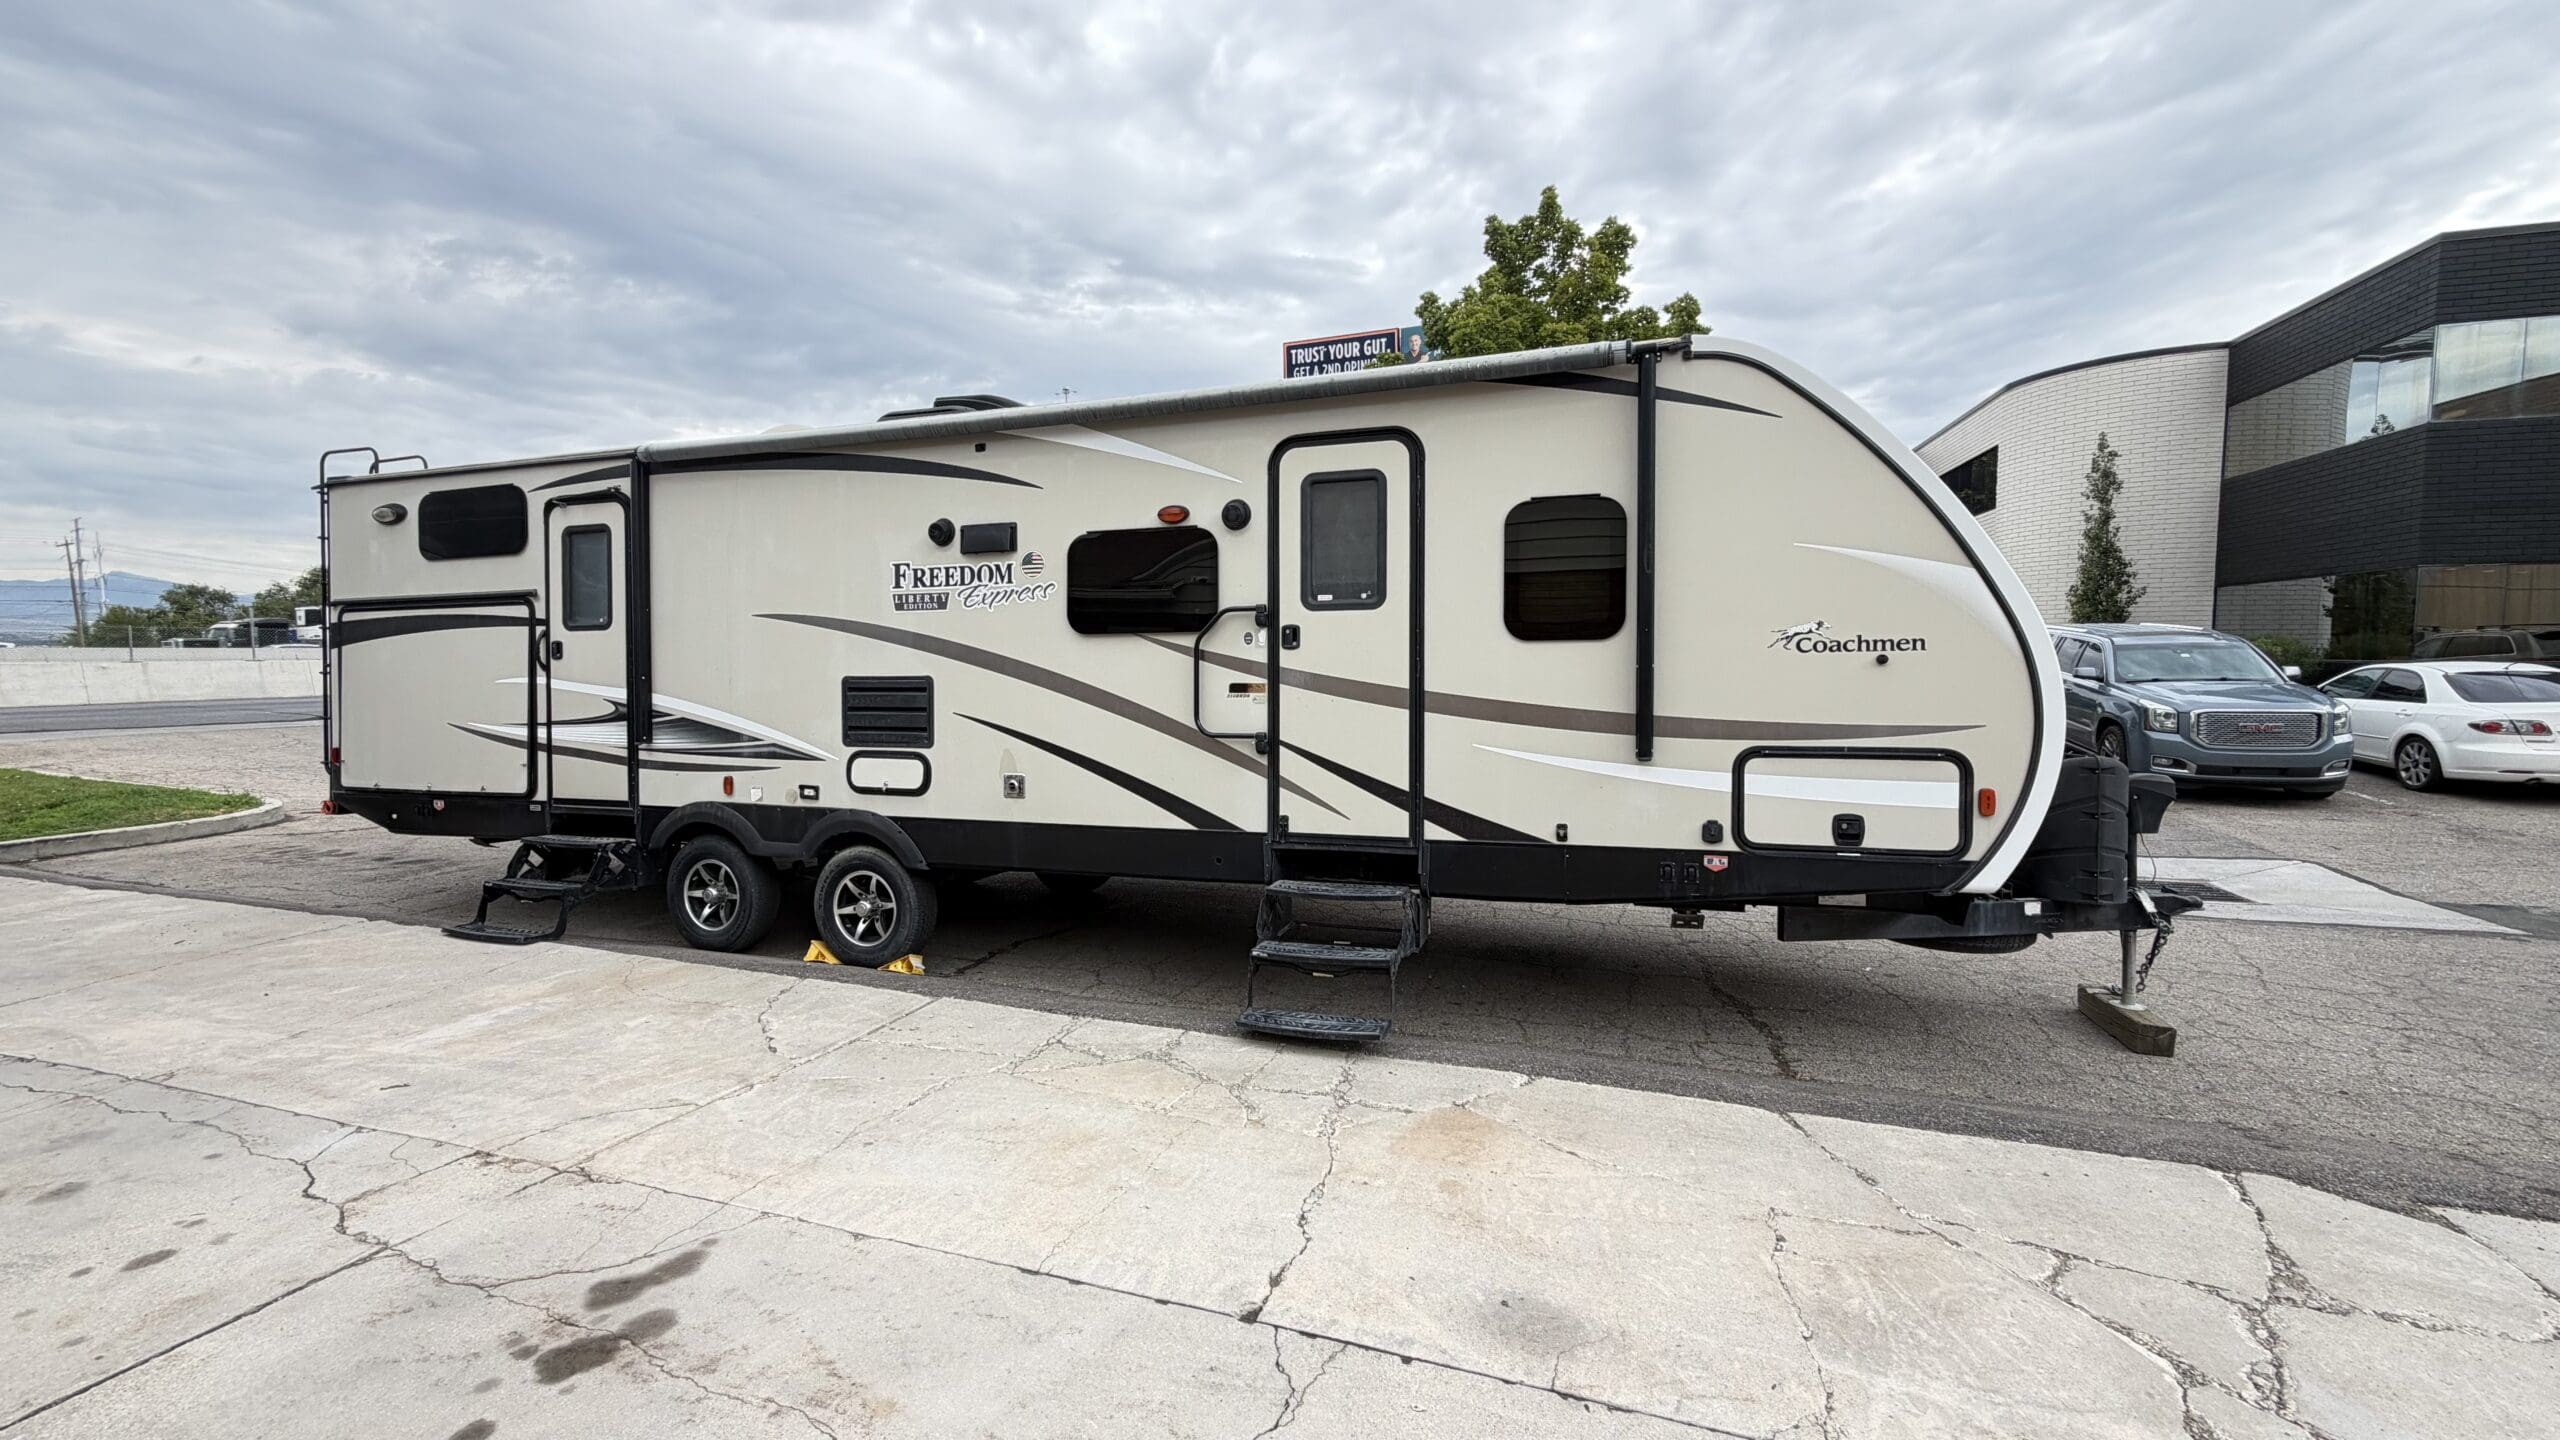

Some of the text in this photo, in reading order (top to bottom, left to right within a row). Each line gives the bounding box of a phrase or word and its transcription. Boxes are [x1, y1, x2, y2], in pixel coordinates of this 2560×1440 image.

[1290, 338, 1391, 365] TRUST YOUR GUT.
[1293, 366, 1311, 378] GET
[1313, 365, 1319, 377] A
[1322, 363, 1341, 375] 2ND
[892, 563, 1014, 590] FREEDOM
[895, 593, 948, 604] LIBERTY
[957, 582, 1056, 610] Express
[904, 602, 938, 611] EDITION
[1795, 634, 1927, 654] Coachmen
[2239, 722, 2284, 734] GMC
